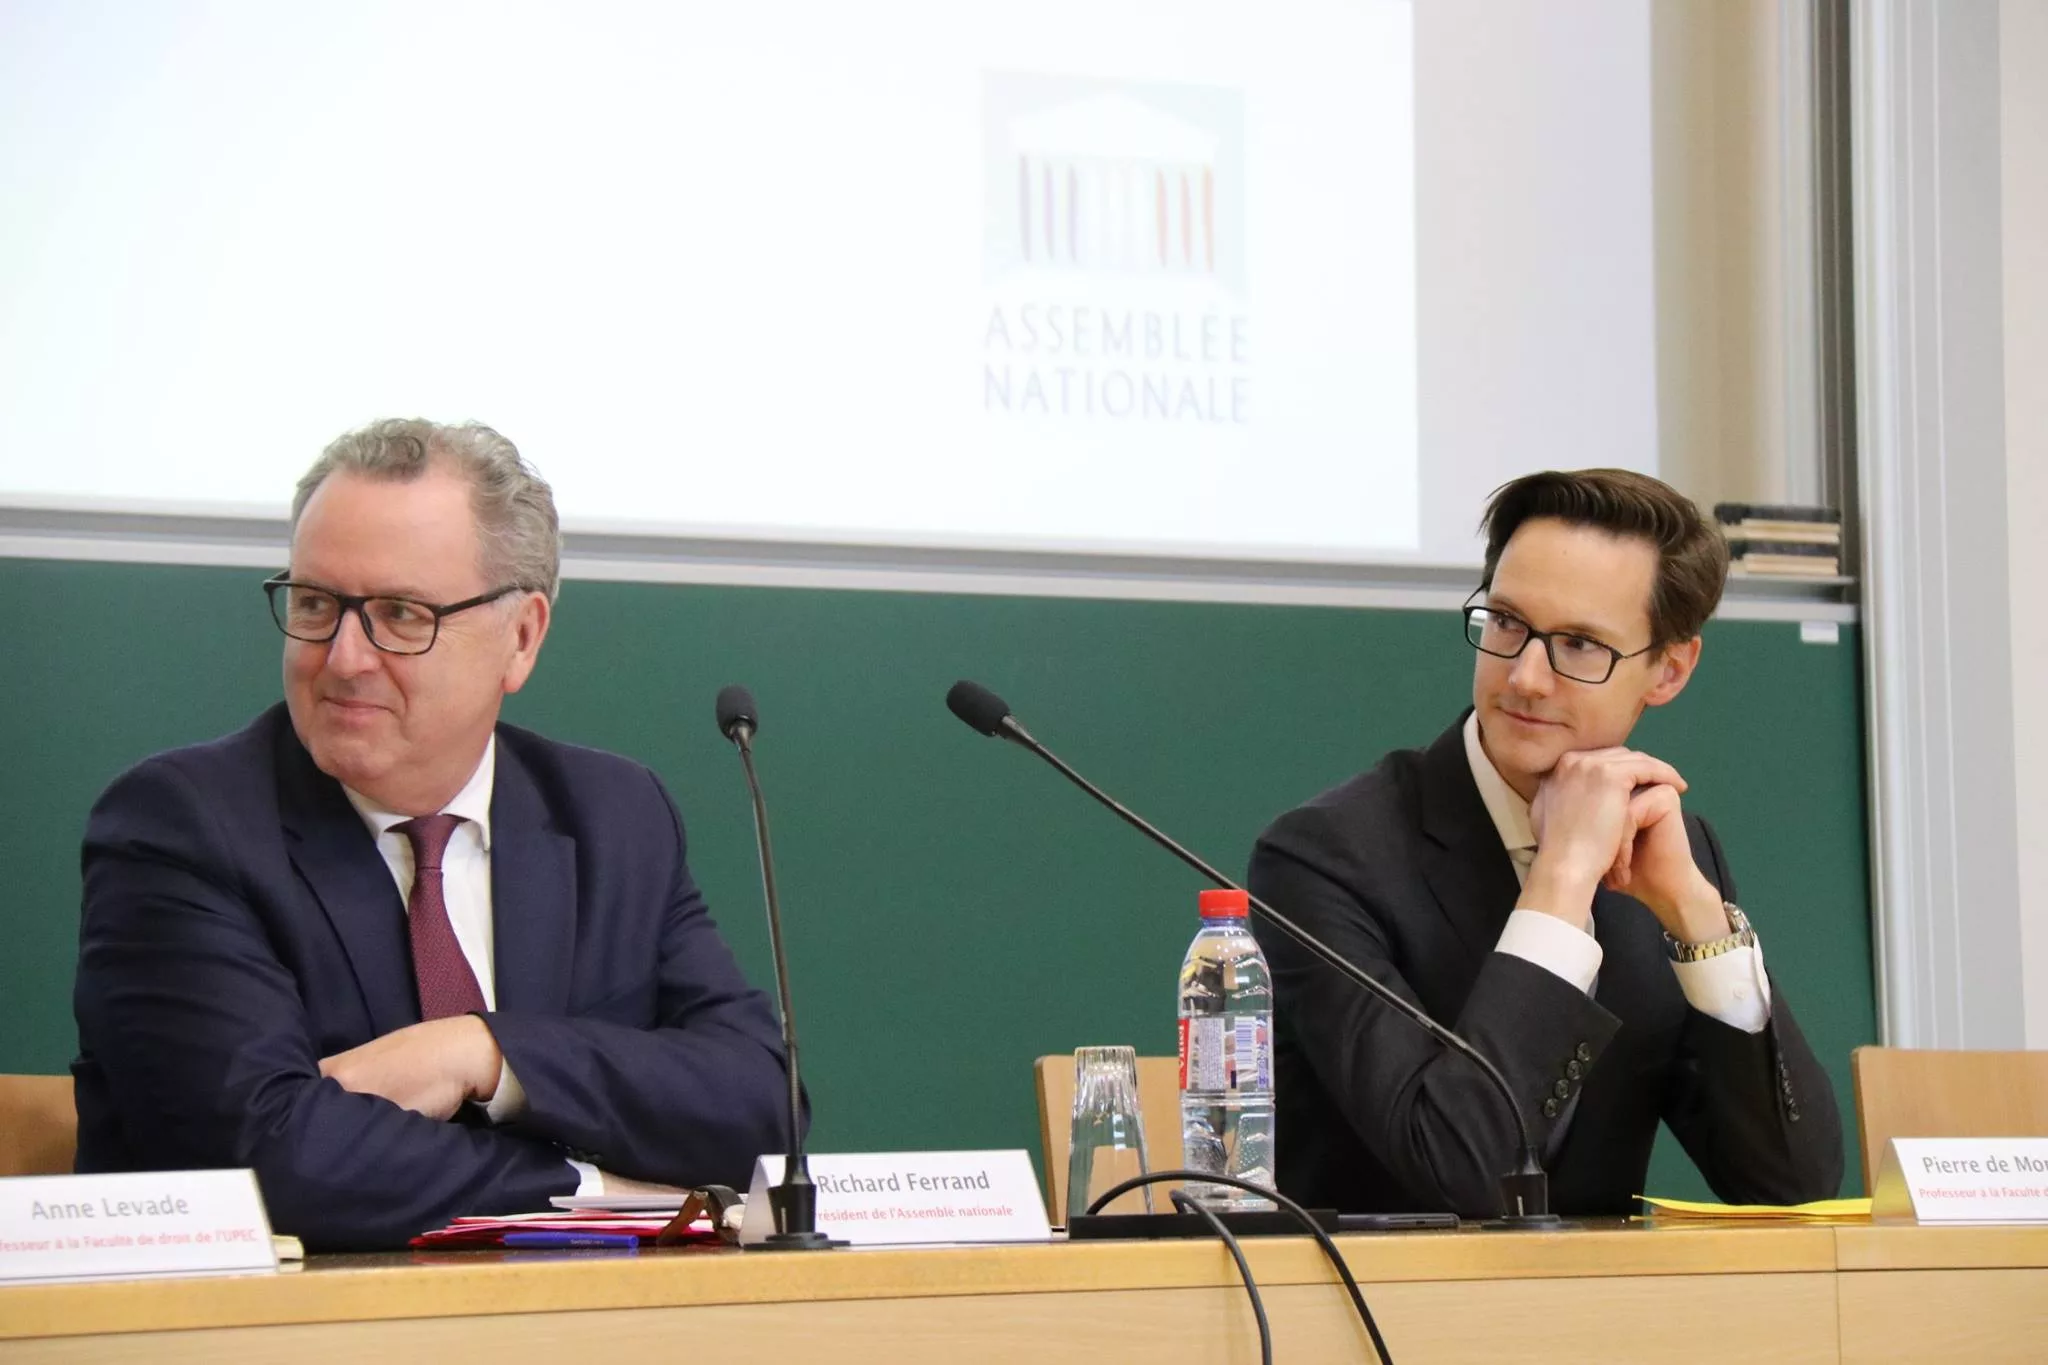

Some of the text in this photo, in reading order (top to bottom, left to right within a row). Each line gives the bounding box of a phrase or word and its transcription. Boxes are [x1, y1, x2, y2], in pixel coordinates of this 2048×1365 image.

[982, 301, 1250, 364] ASSEMBLÉE
[982, 362, 1250, 425] NATIONALE
[1922, 1156, 1982, 1174] Pierre
[1986, 1155, 2011, 1173] de
[816, 1170, 991, 1194] Richard Ferrand
[1919, 1187, 1976, 1199] Professeur
[1989, 1188, 2000, 1198] la
[31, 1195, 190, 1220] Anne Levade
[814, 1208, 869, 1222] résident
[872, 1208, 887, 1221] de
[958, 1205, 1014, 1217] nationale
[67, 1236, 81, 1249] la
[137, 1232, 155, 1246] de
[158, 1231, 191, 1245] droit
[194, 1230, 213, 1244] de
